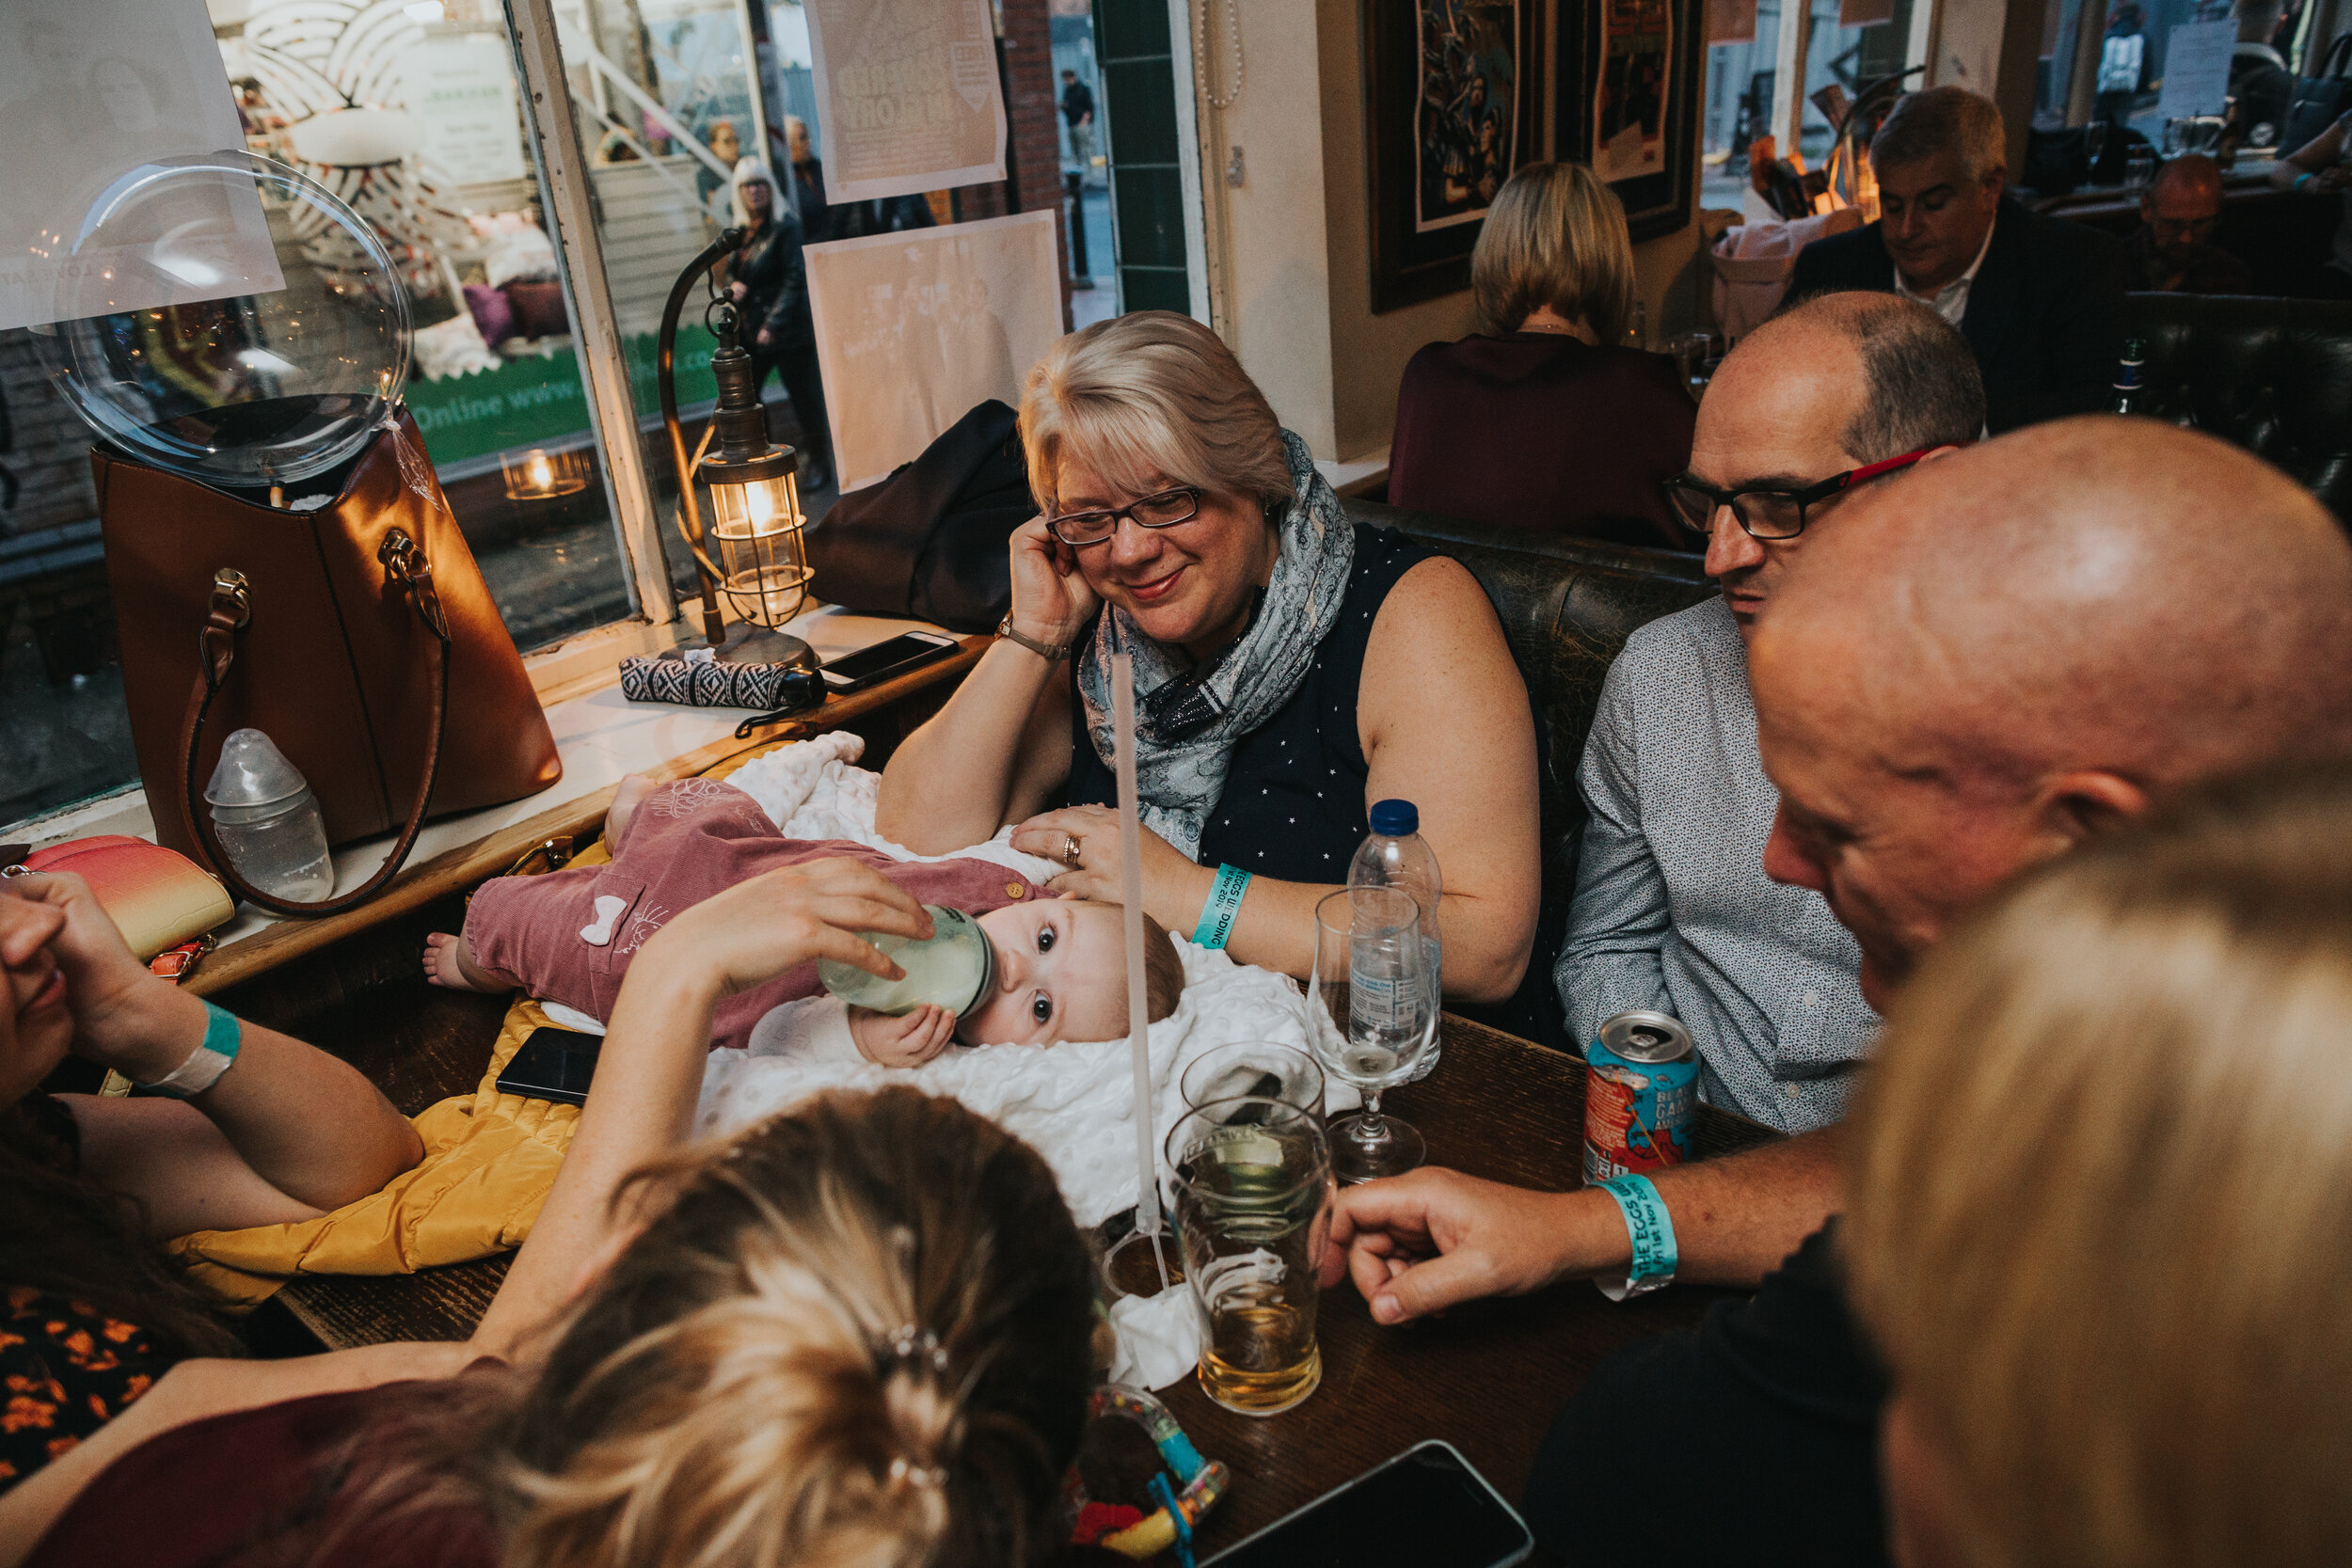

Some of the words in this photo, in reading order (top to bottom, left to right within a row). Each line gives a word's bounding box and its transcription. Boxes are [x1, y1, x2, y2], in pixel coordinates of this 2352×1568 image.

[413, 396, 503, 433] Online
[1215, 890, 1229, 910] 2019
[1229, 874, 1247, 898] EGGS
[1211, 898, 1237, 946] WEDDING
[1625, 1199, 1648, 1241] EGGS
[1644, 1204, 1658, 1227] Nov
[1636, 1245, 1651, 1273] THE
